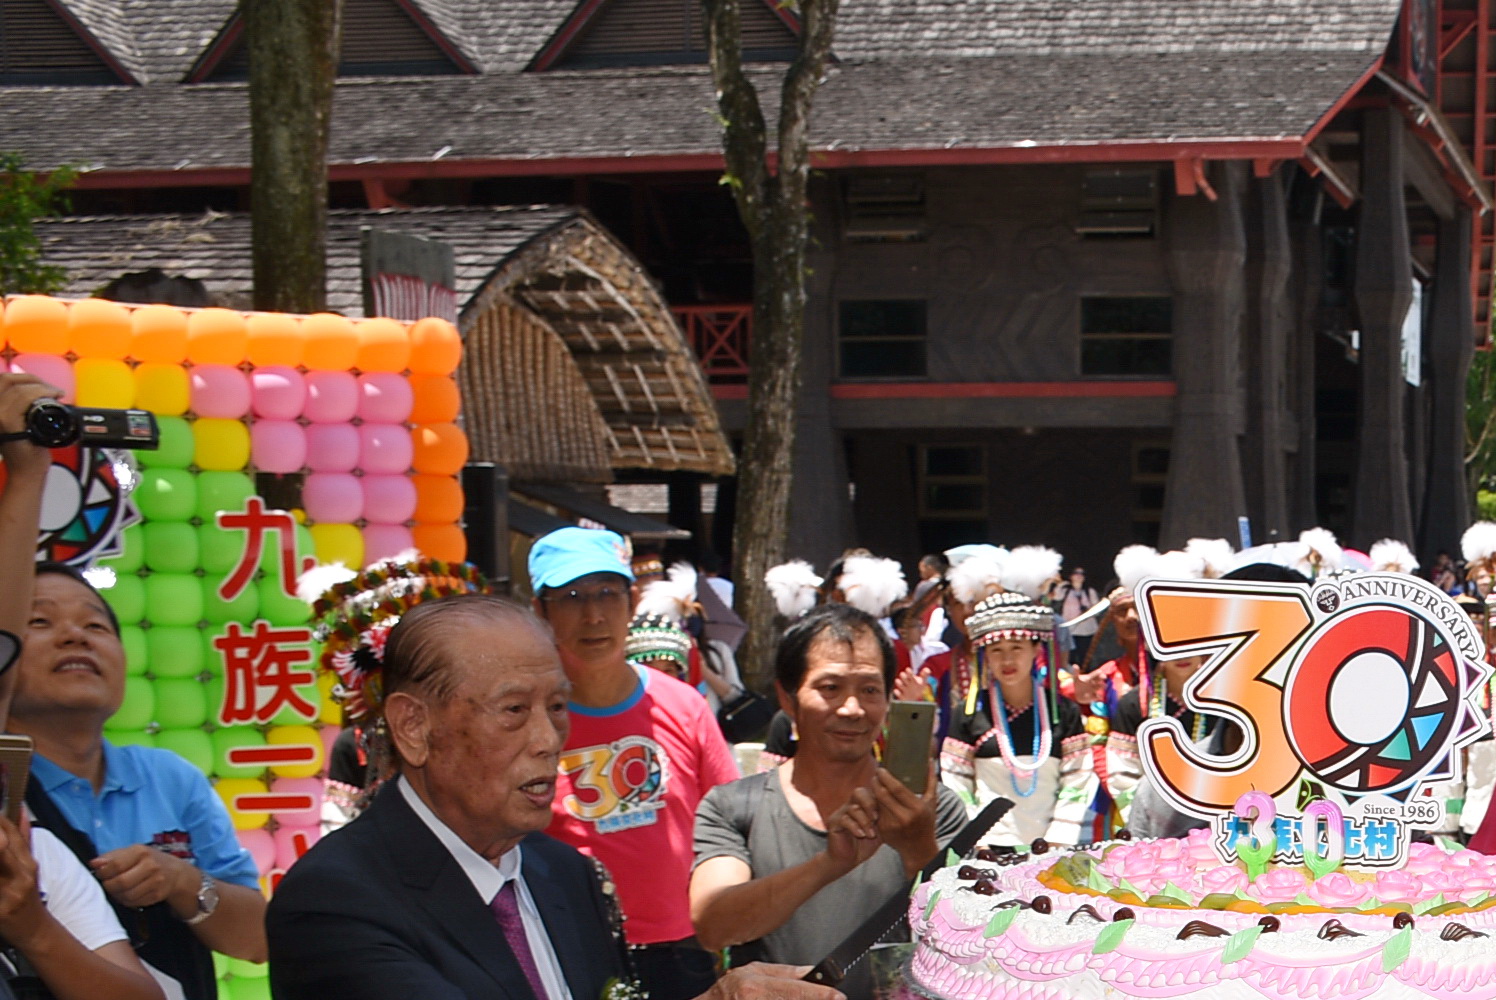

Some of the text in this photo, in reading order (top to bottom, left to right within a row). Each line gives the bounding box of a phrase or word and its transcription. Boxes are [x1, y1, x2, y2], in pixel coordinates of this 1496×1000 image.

[1343, 580, 1476, 660] ANNIVERSARY
[1147, 585, 1465, 808] 30
[559, 746, 662, 820] 30
[1363, 803, 1435, 818] Since 1986
